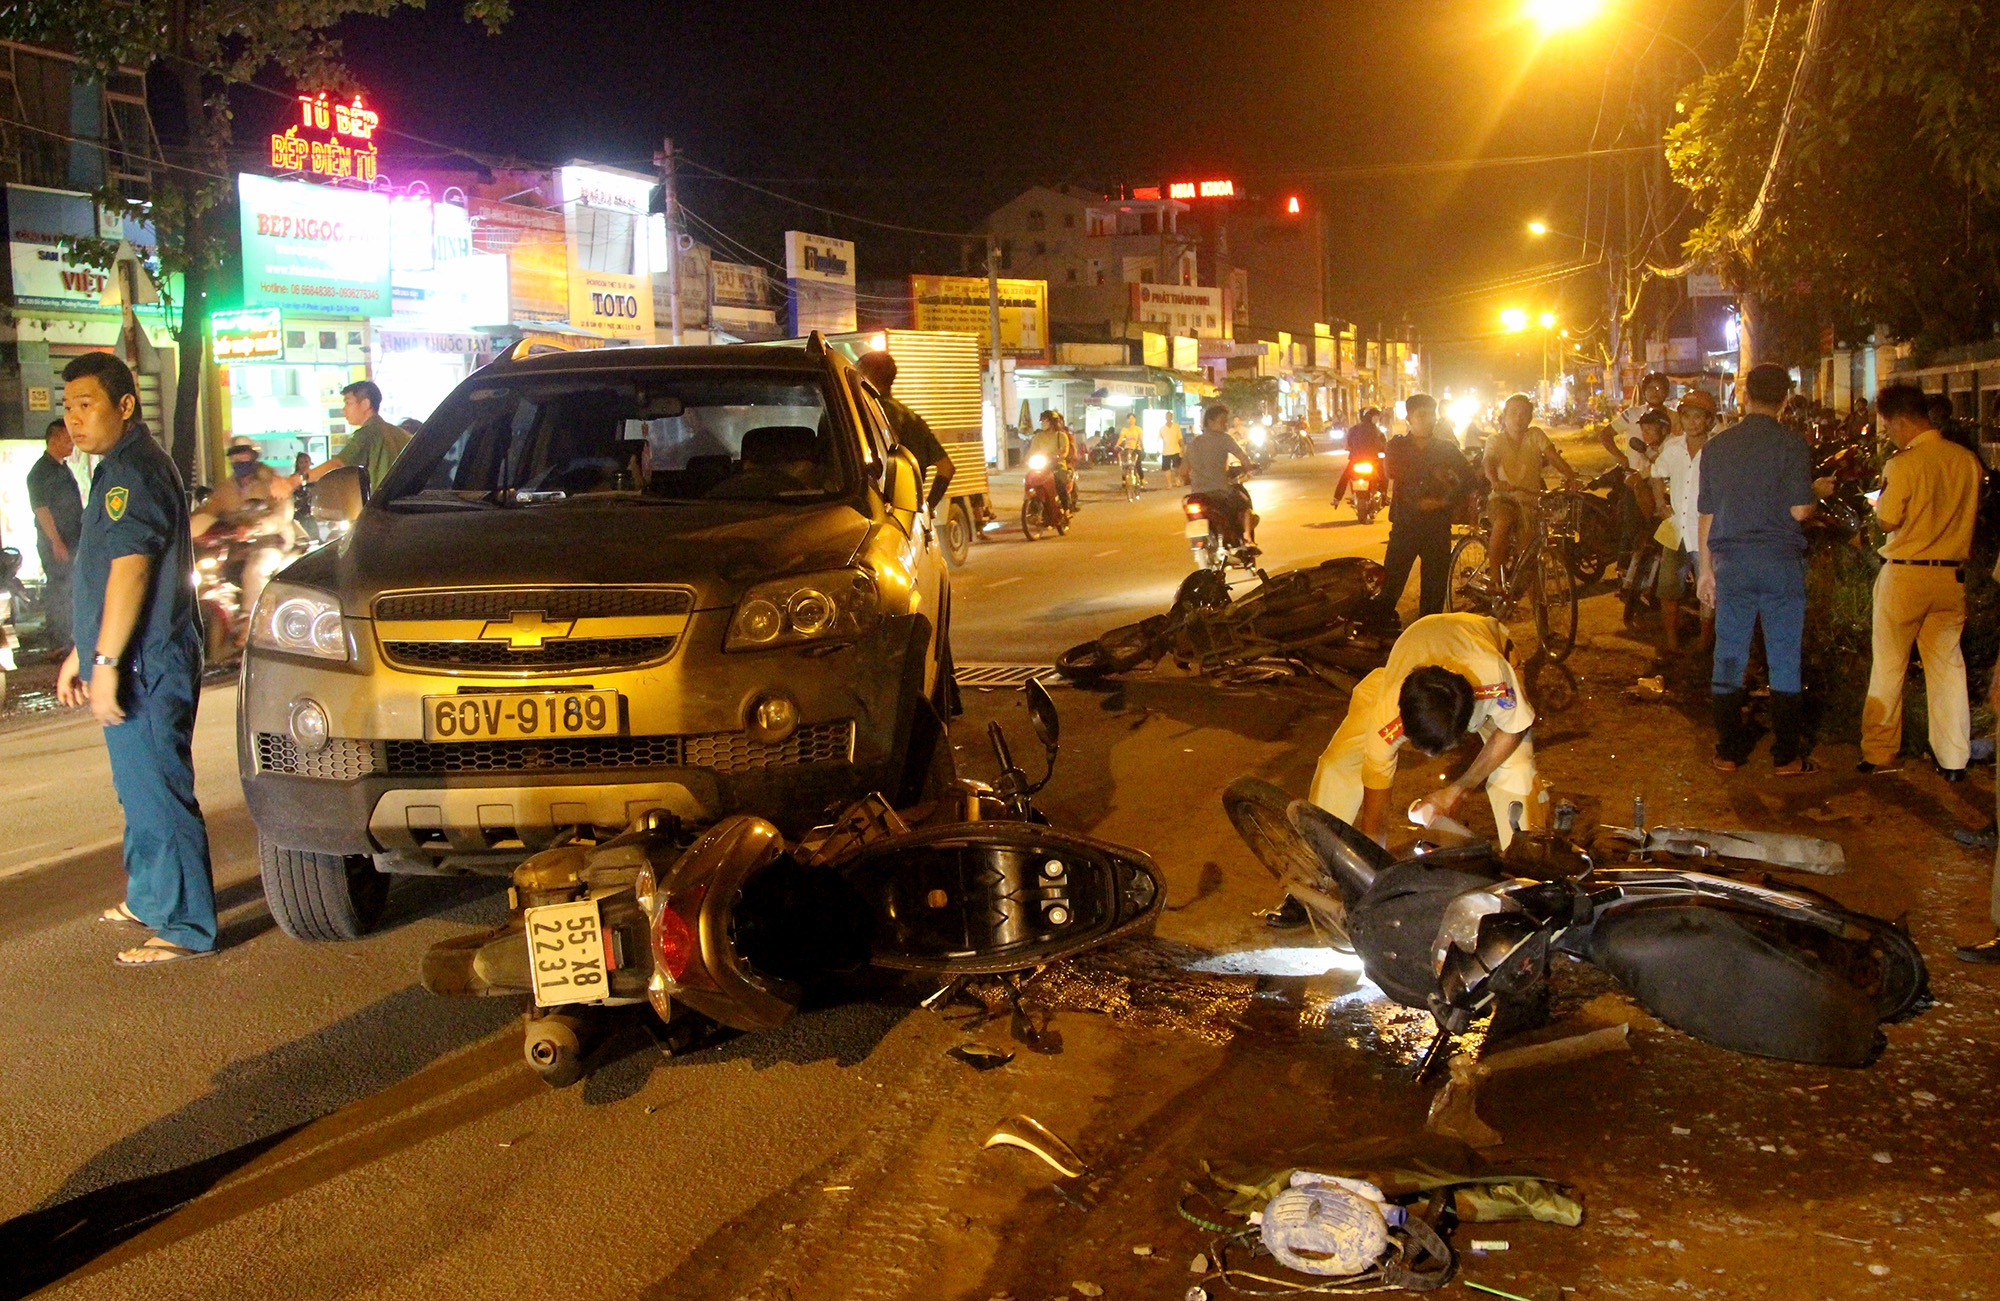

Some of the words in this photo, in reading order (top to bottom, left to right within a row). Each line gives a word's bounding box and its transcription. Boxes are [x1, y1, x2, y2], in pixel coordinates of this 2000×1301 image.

[1169, 182, 1196, 199] NHA
[1200, 180, 1234, 197] KHOA
[591, 292, 638, 319] TOTO
[435, 694, 607, 737] 60V-9189
[533, 920, 570, 988] 2231
[566, 915, 602, 987] 55-X8
